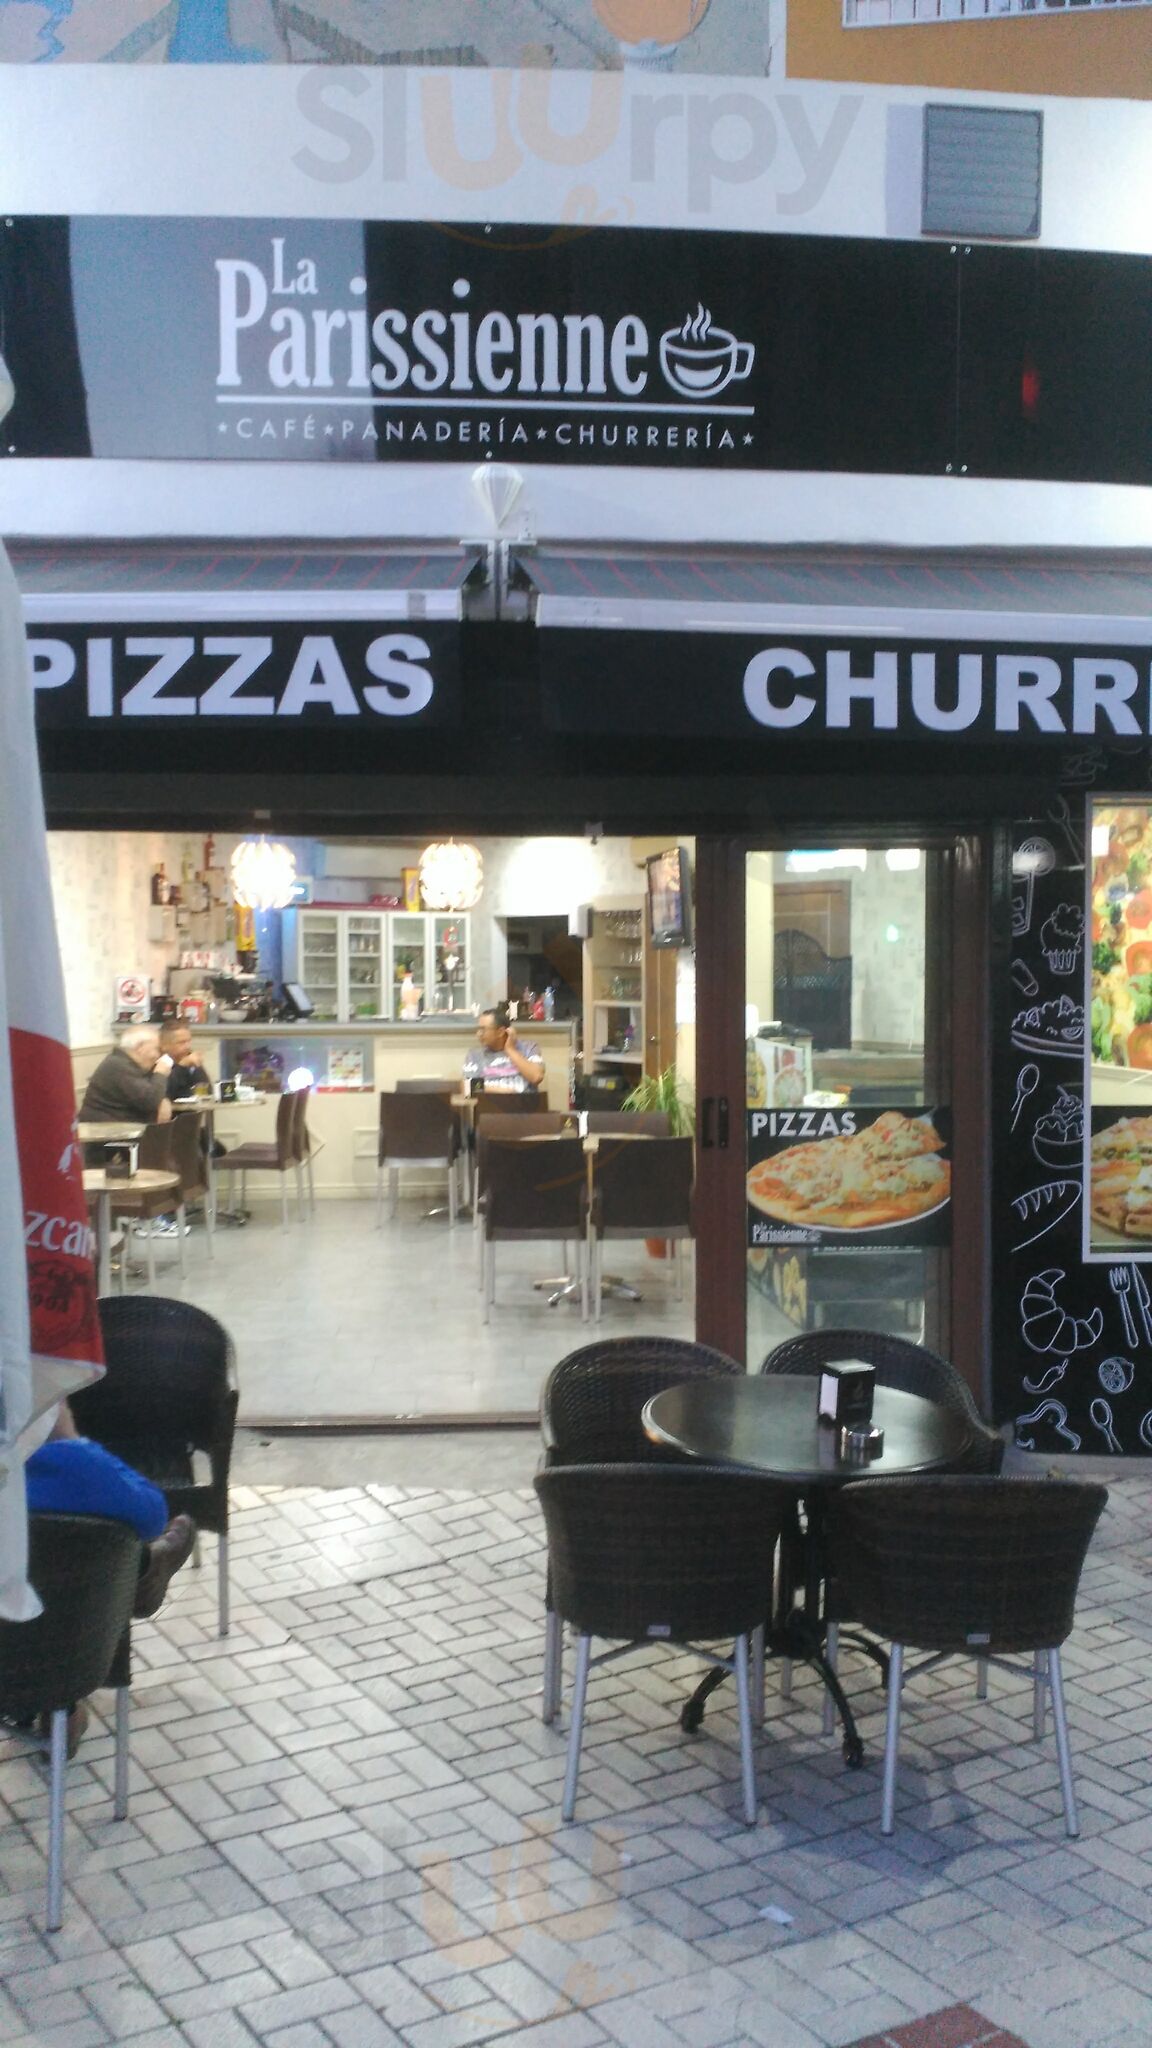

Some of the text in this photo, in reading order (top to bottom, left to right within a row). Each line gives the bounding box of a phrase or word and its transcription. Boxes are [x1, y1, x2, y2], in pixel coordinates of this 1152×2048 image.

[271, 238, 318, 294] La
[214, 258, 649, 396] Parissienne
[236, 414, 735, 449] CAFÉ PANADERÍA CHURRERÍA
[26, 633, 434, 717] PIZZAS
[742, 647, 1152, 736] CHURR
[751, 1111, 857, 1137] PIZZAS
